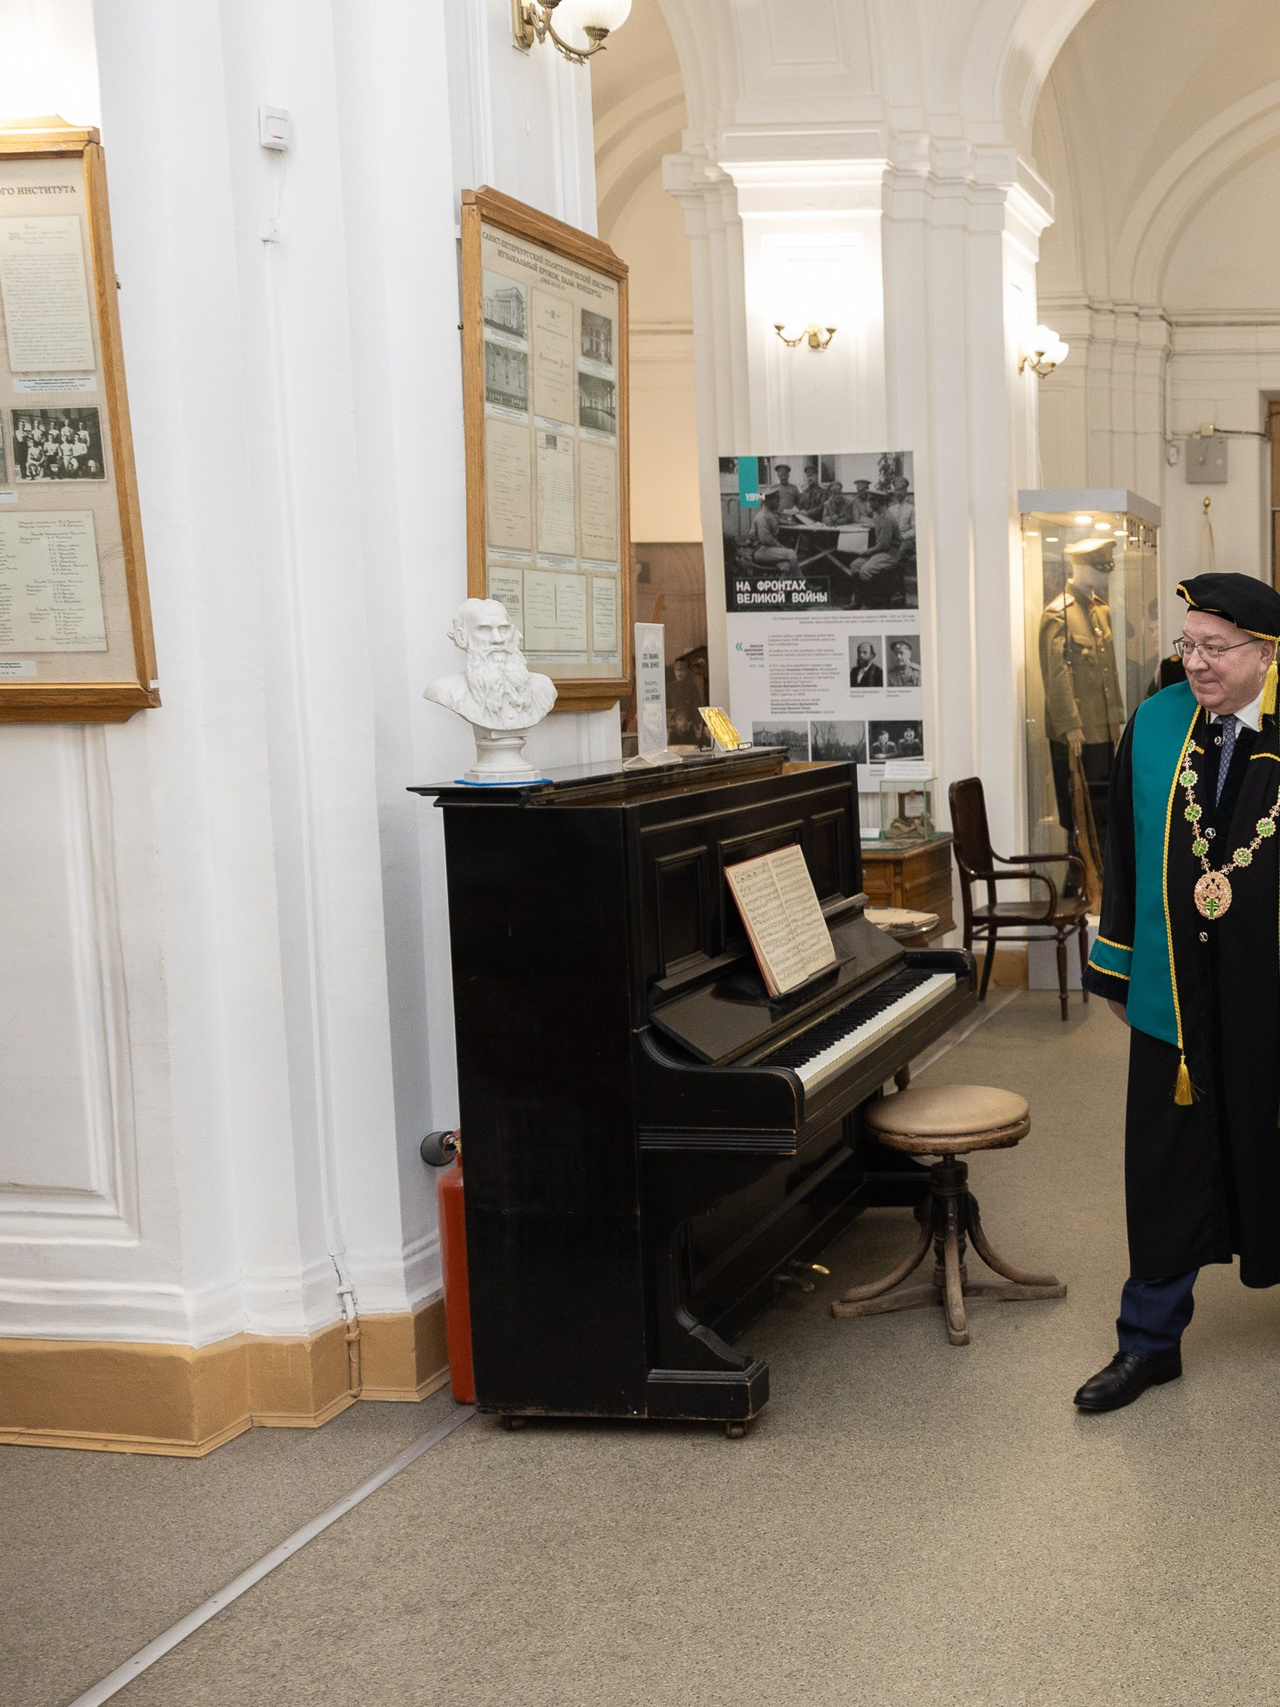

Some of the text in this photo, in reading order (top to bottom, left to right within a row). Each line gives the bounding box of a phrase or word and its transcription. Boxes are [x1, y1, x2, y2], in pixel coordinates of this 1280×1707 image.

[0, 185, 76, 195] ГО ИНСТИТУТА
[745, 492, 766, 502] 1914
[736, 580, 806, 592] НА ФРОНТАХ
[736, 590, 828, 604] ВЕЛИКОЙ ВОЙНЫ
